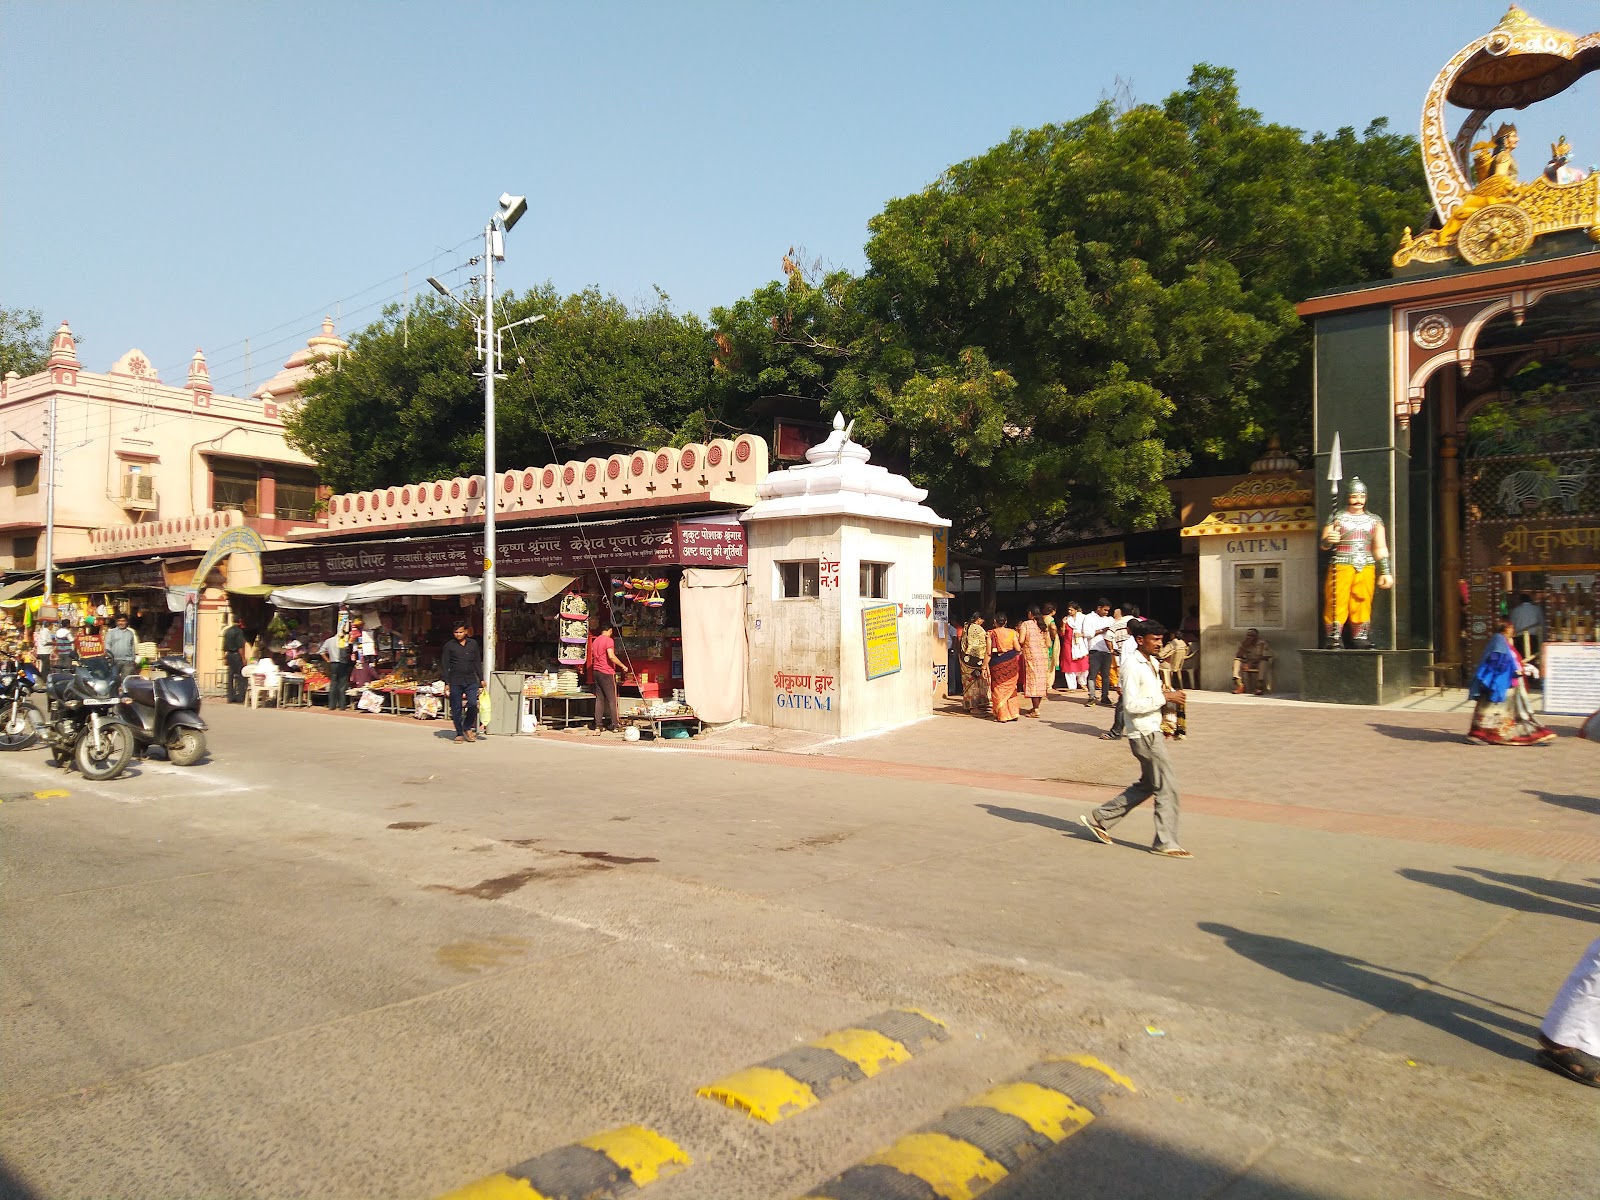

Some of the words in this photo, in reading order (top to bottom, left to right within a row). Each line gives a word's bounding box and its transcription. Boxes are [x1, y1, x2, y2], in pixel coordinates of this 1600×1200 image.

[570, 536, 606, 551] केशव
[608, 535, 638, 552] पूजा
[640, 530, 674, 545] केन्द्र
[682, 530, 700, 544] मुकुट
[701, 527, 723, 540] पोशाक
[498, 543, 525, 557] कृष्ण
[699, 547, 713, 561] धातु
[713, 544, 722, 556] की
[1226, 539, 1268, 553] GATE
[359, 550, 386, 568] गिफ्ट
[821, 556, 840, 573] गेट
[773, 670, 812, 693] श्रीकृष्ण
[814, 675, 835, 694] द्वार
[777, 693, 812, 709] GATE
